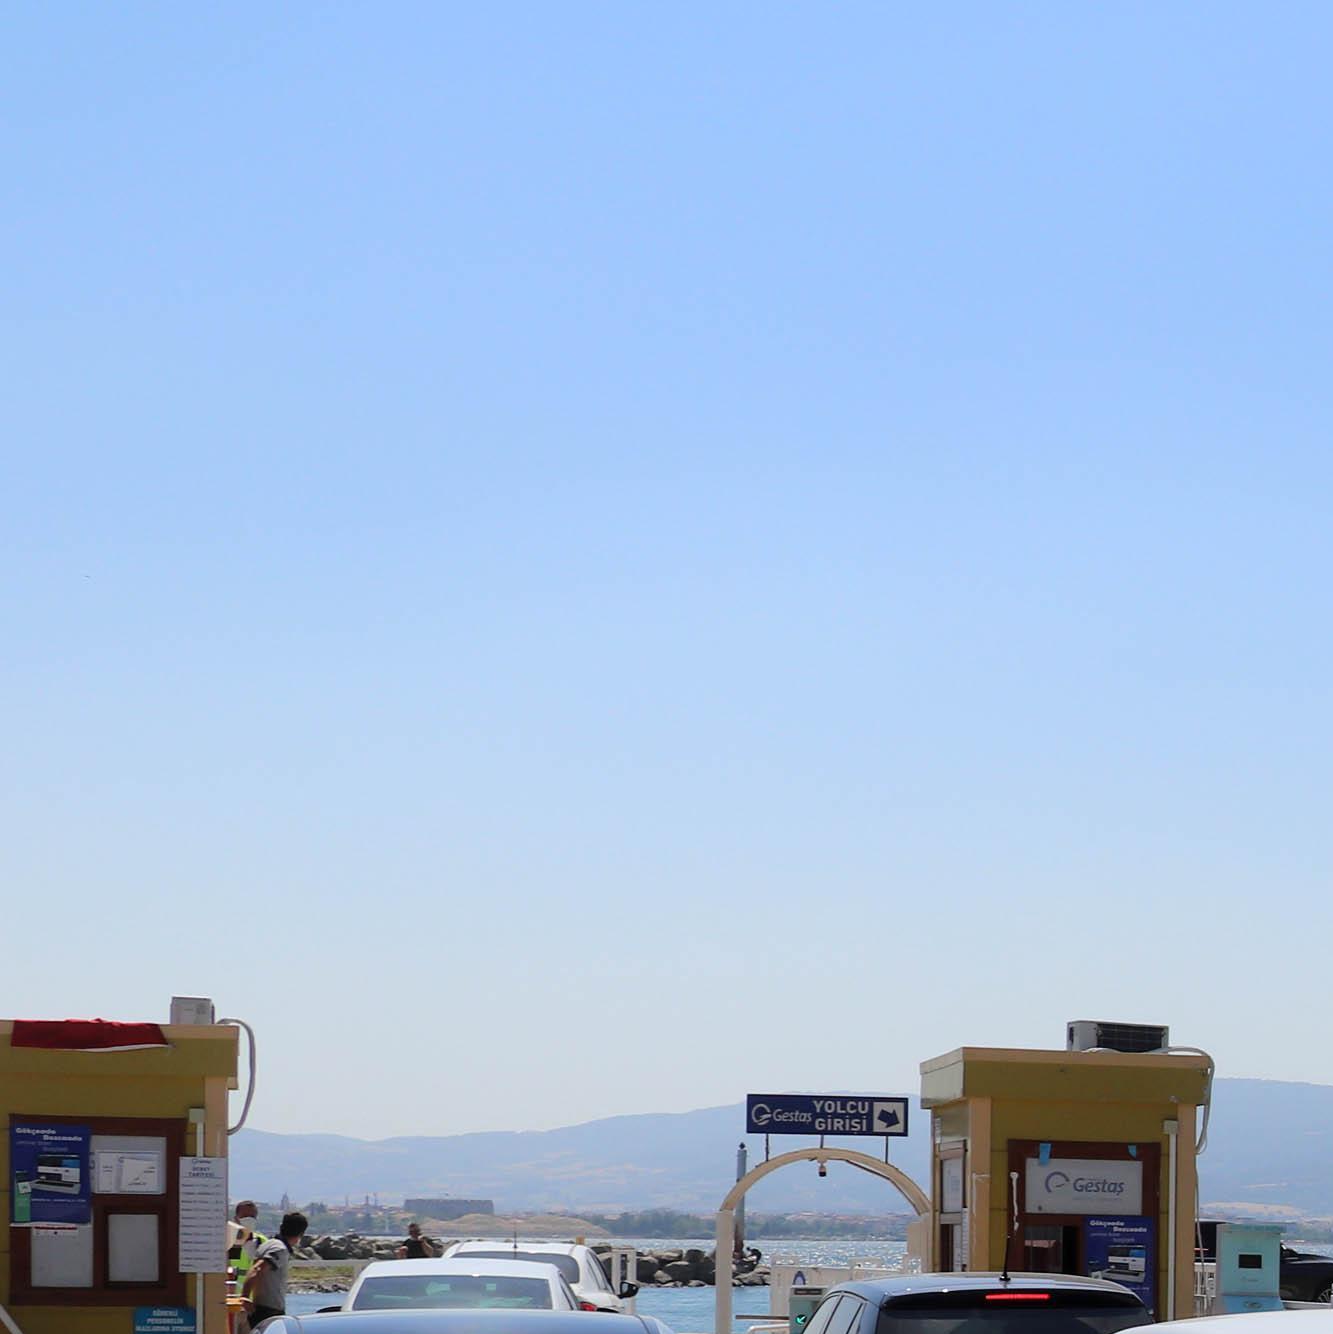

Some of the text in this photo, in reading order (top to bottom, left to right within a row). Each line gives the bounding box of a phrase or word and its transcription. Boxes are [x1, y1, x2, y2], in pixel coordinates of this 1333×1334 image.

[812, 1100, 870, 1115] YOLCU
[772, 1108, 812, 1125] Gestaş
[1072, 1176, 1126, 1196] Gestaş
